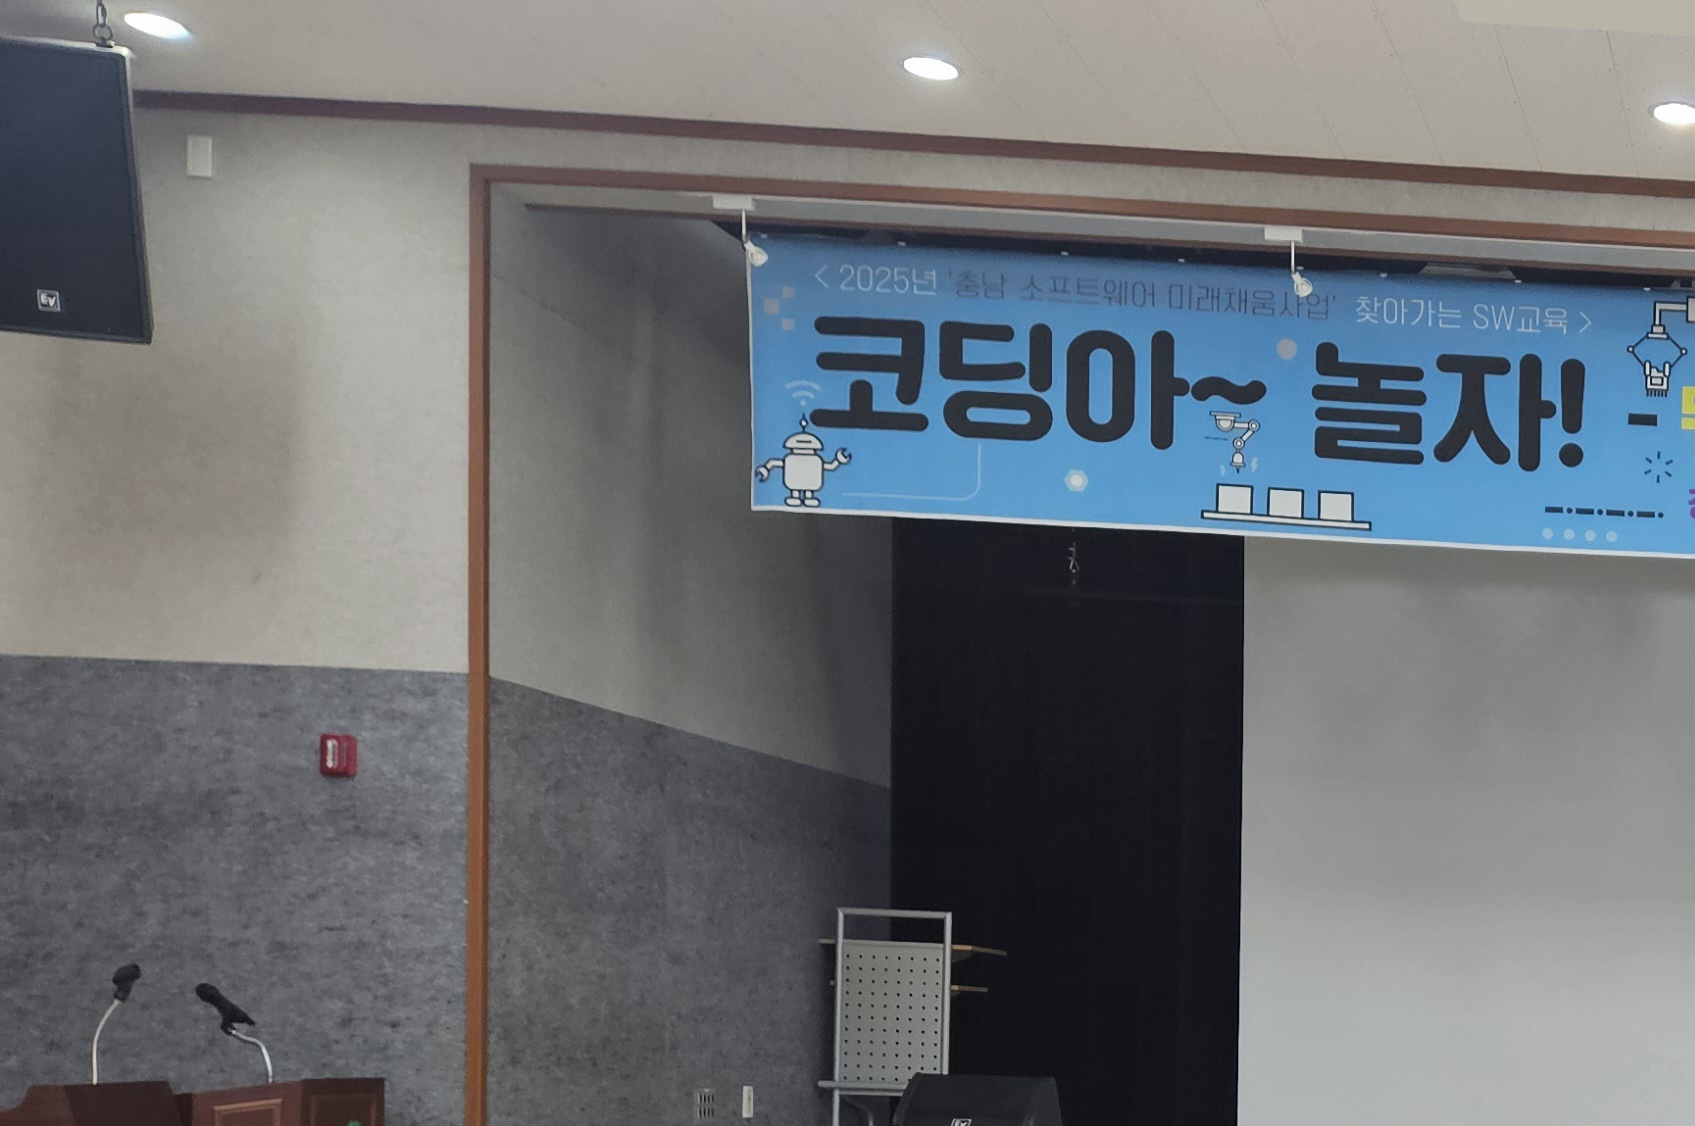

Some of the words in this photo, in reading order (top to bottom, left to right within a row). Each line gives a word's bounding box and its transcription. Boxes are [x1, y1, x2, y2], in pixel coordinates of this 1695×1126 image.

[838, 263, 937, 296] 2025년
[1019, 273, 1156, 309] 소프트웨어
[1355, 295, 1462, 329] 찾아가는
[1472, 303, 1569, 334] SW교육
[808, 315, 1268, 451] 코딩아~
[1310, 341, 1588, 473] 놀자!
